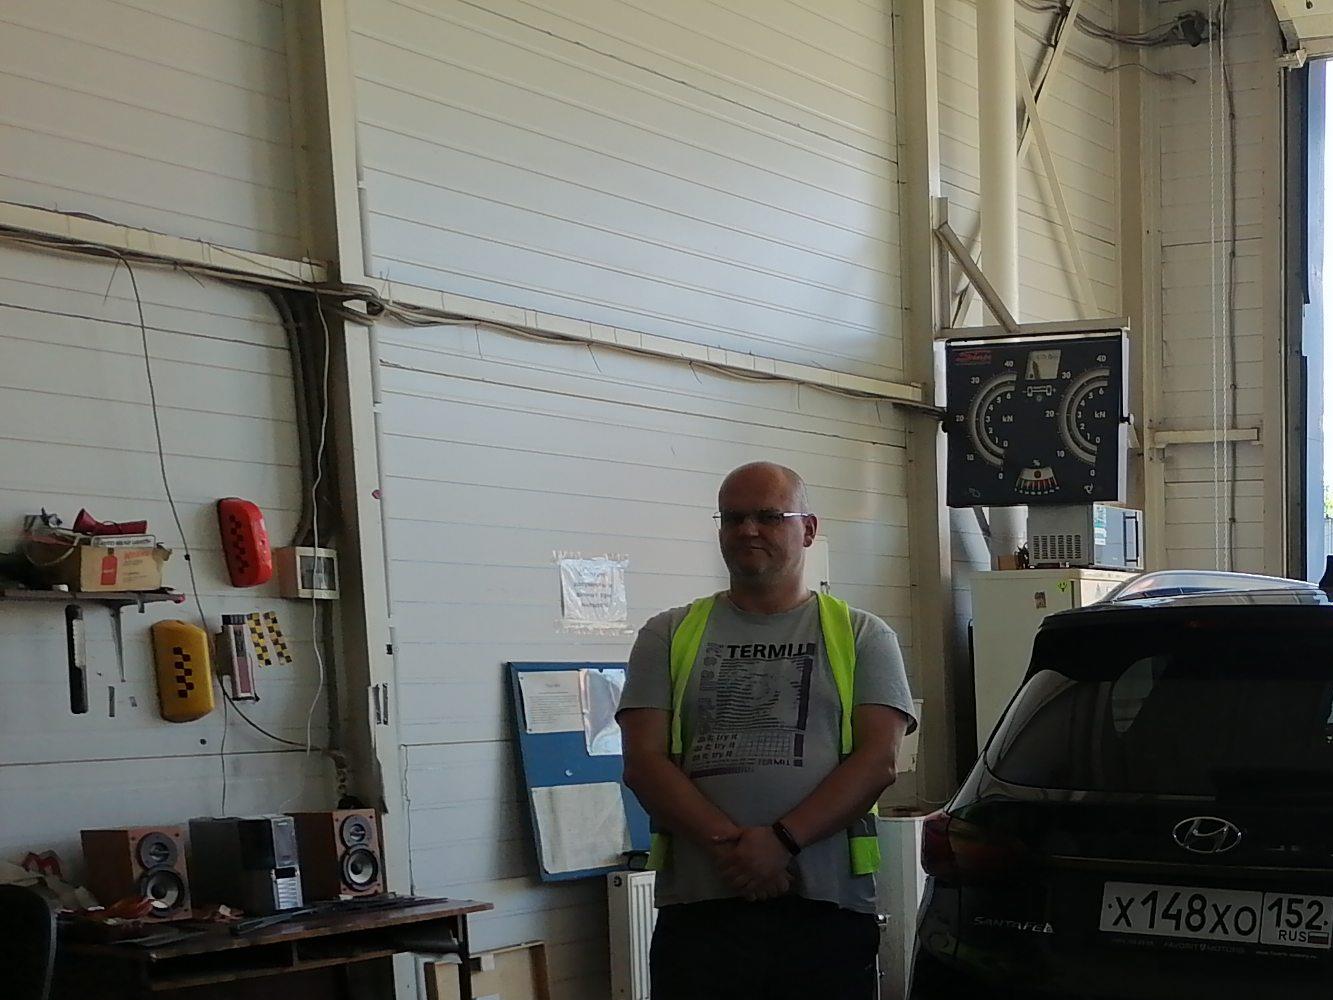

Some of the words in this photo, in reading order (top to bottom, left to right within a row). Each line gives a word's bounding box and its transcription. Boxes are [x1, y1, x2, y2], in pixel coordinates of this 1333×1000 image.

[1045, 410, 1055, 418] 20
[1268, 898, 1324, 931] 152
[1278, 930, 1307, 942] RUS
